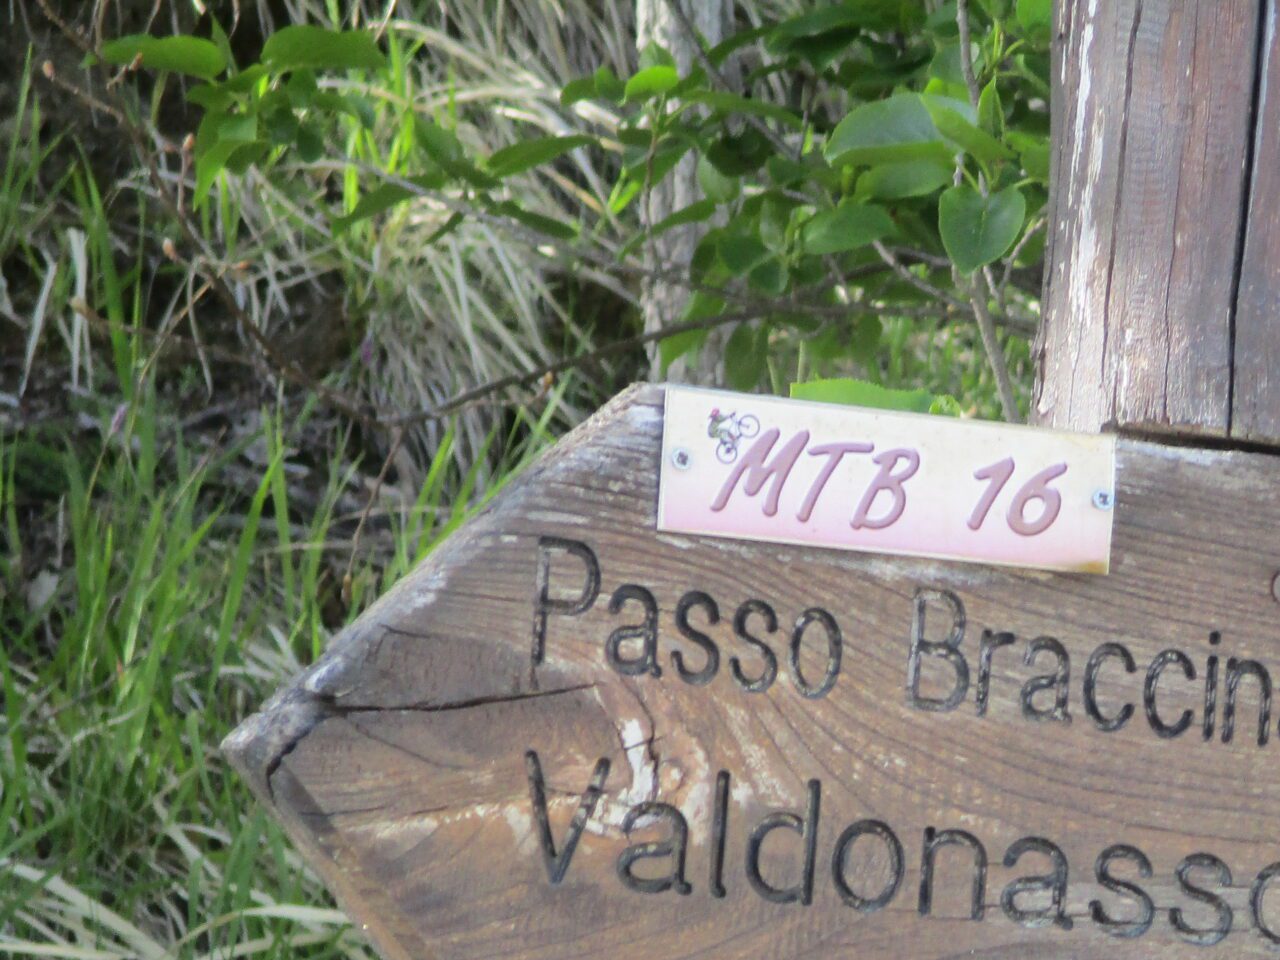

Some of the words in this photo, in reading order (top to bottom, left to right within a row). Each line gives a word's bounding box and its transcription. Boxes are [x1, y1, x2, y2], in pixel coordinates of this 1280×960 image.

[710, 427, 920, 530] MTB
[966, 456, 1069, 537] 16
[529, 535, 843, 699] Passo
